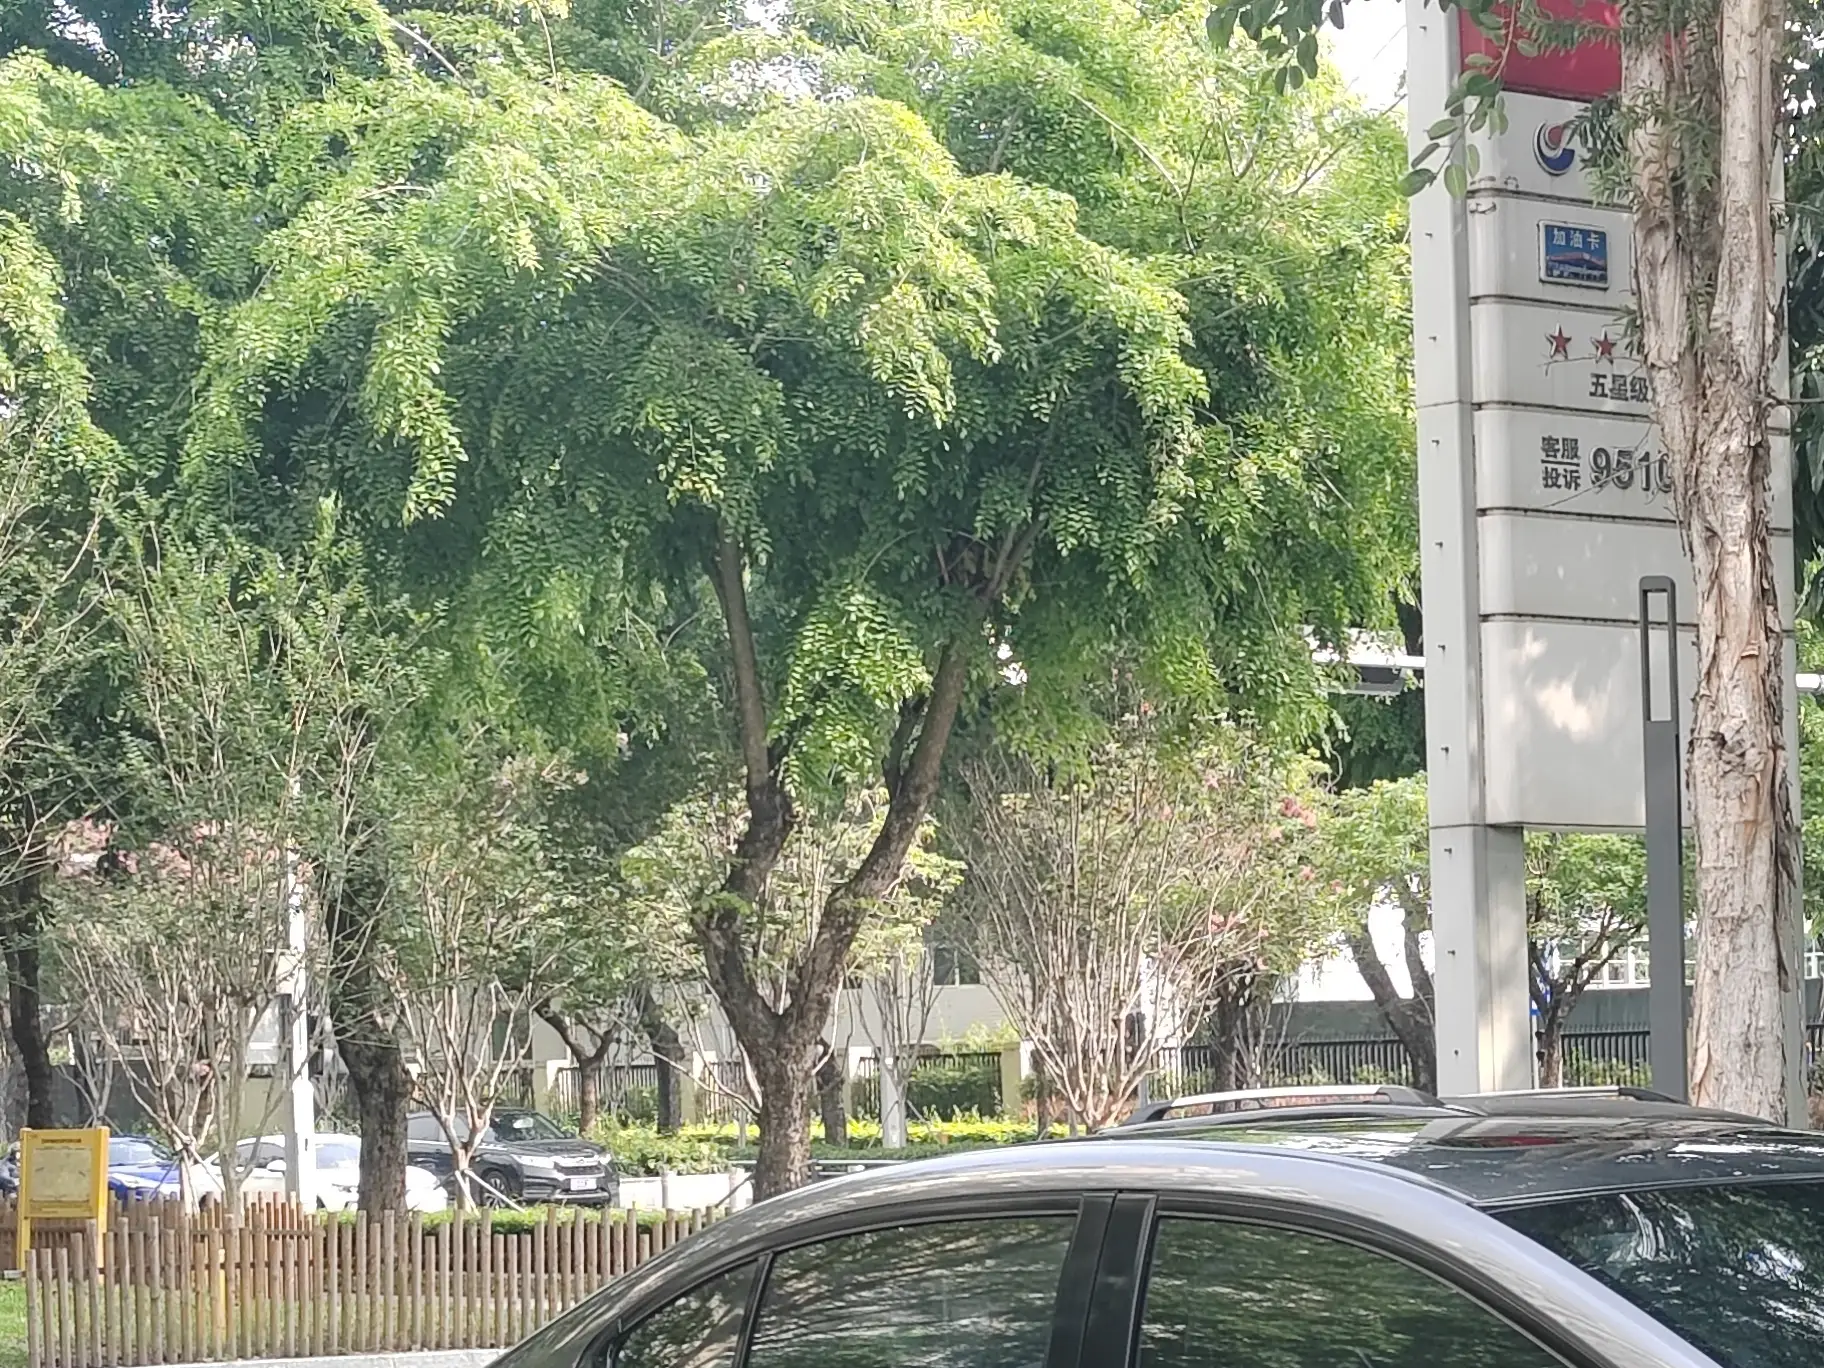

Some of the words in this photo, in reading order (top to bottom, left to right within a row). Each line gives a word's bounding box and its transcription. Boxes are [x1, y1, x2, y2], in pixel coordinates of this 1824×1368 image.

[1552, 227, 1601, 250] 加油卡
[1588, 372, 1649, 403] 五星级
[1540, 435, 1580, 460] 客服
[1542, 466, 1581, 491] 投诉
